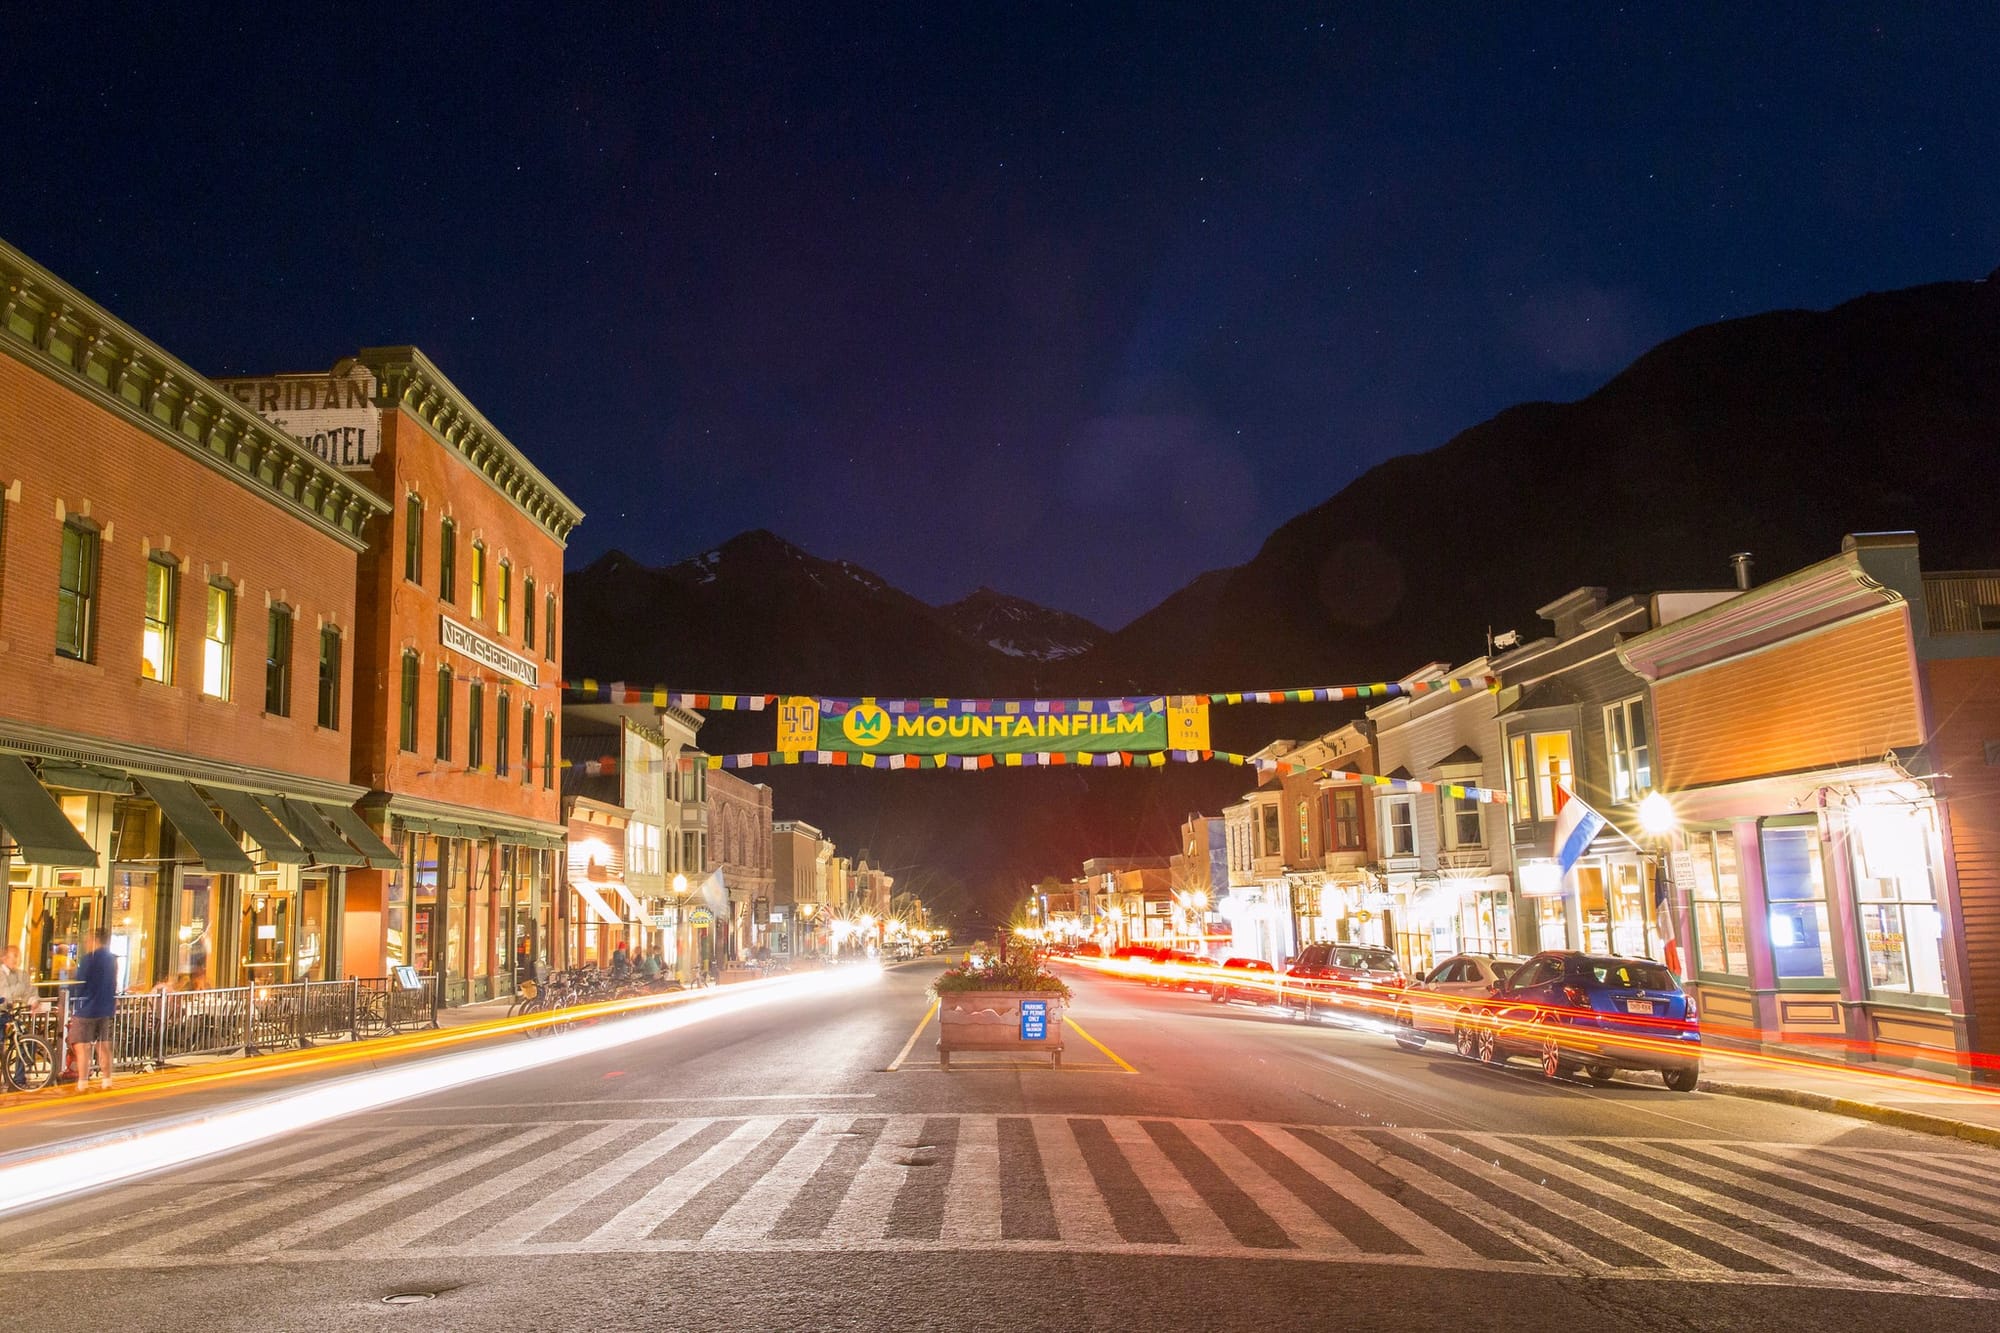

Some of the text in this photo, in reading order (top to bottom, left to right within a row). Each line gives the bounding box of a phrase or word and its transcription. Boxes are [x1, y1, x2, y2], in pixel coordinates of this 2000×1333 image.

[444, 621, 534, 682] NEW SHERIDAN
[783, 706, 814, 733] 40
[897, 711, 1144, 737] MOUNTAINFILM
[782, 735, 813, 743] YEARS
